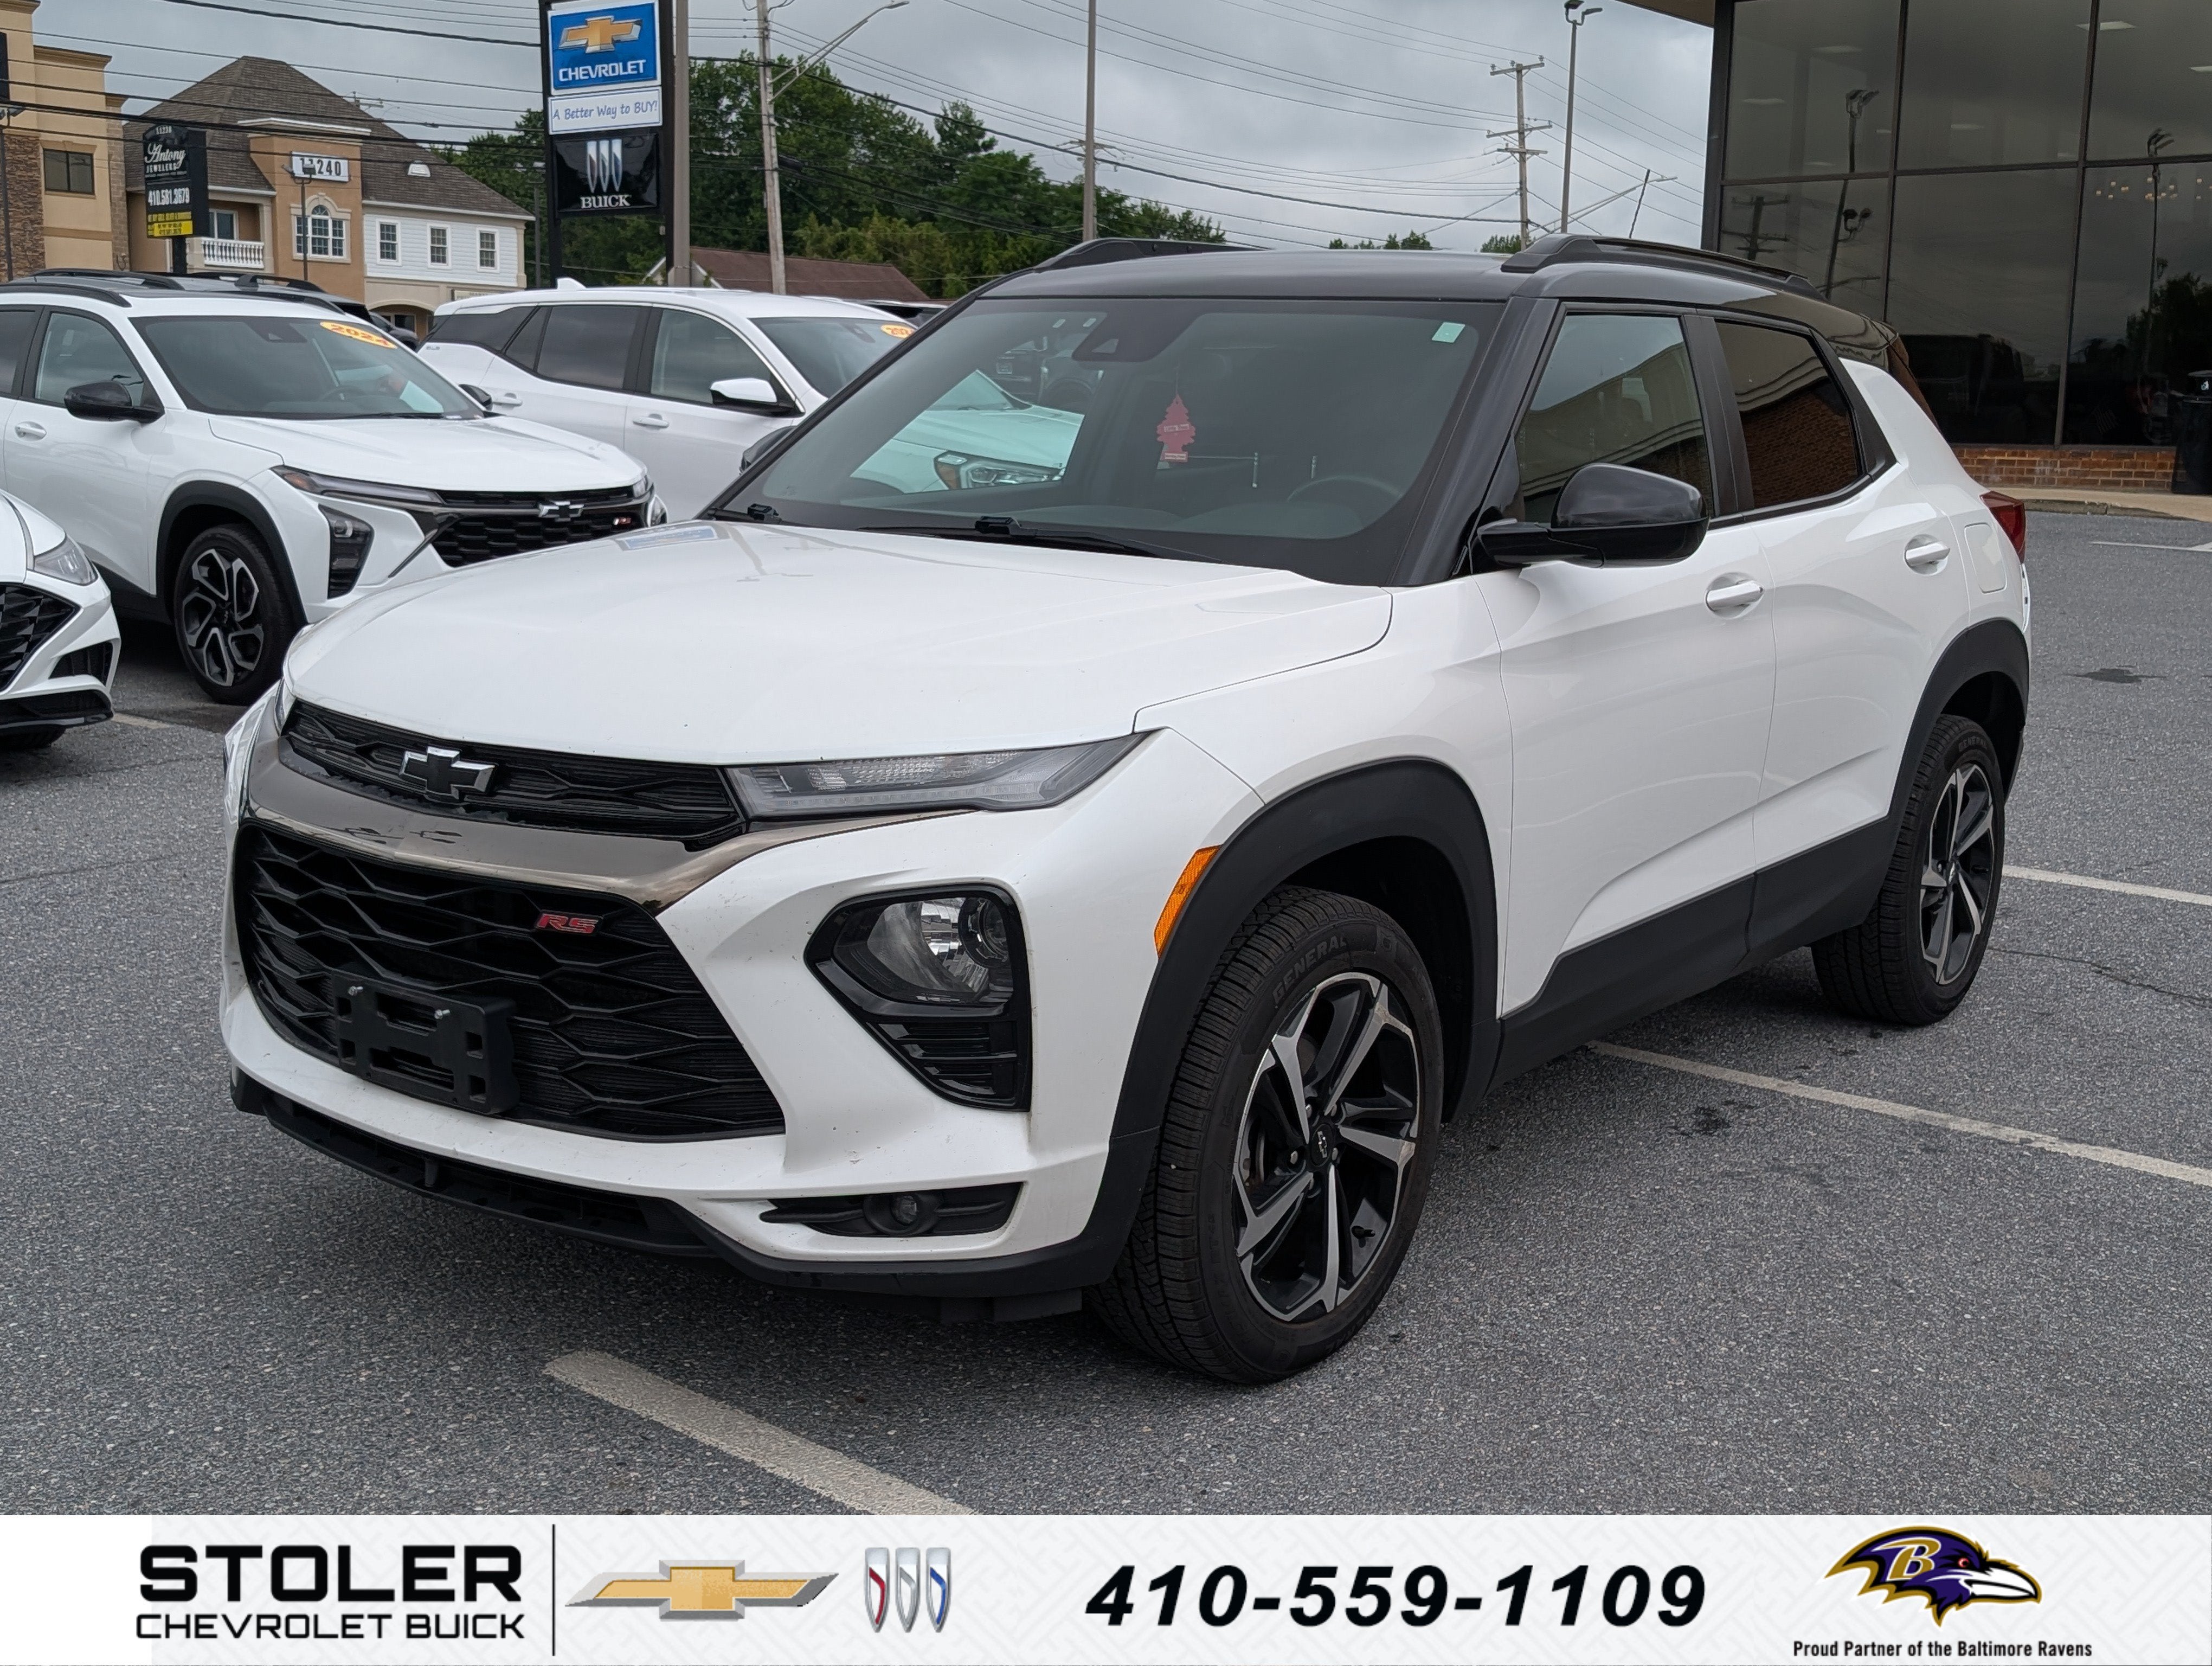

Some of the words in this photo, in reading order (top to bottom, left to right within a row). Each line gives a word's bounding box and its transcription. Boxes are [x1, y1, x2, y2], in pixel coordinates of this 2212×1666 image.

[558, 59, 646, 82] CHEVROLET
[552, 108, 561, 120] A
[564, 107, 594, 120] Better
[597, 105, 617, 119] Way
[620, 103, 631, 115] to
[634, 100, 658, 114] BUY!
[144, 143, 186, 169] Antony
[580, 194, 632, 209] BUICK
[536, 913, 599, 934] RS
[1272, 935, 1347, 1004] GENERAL
